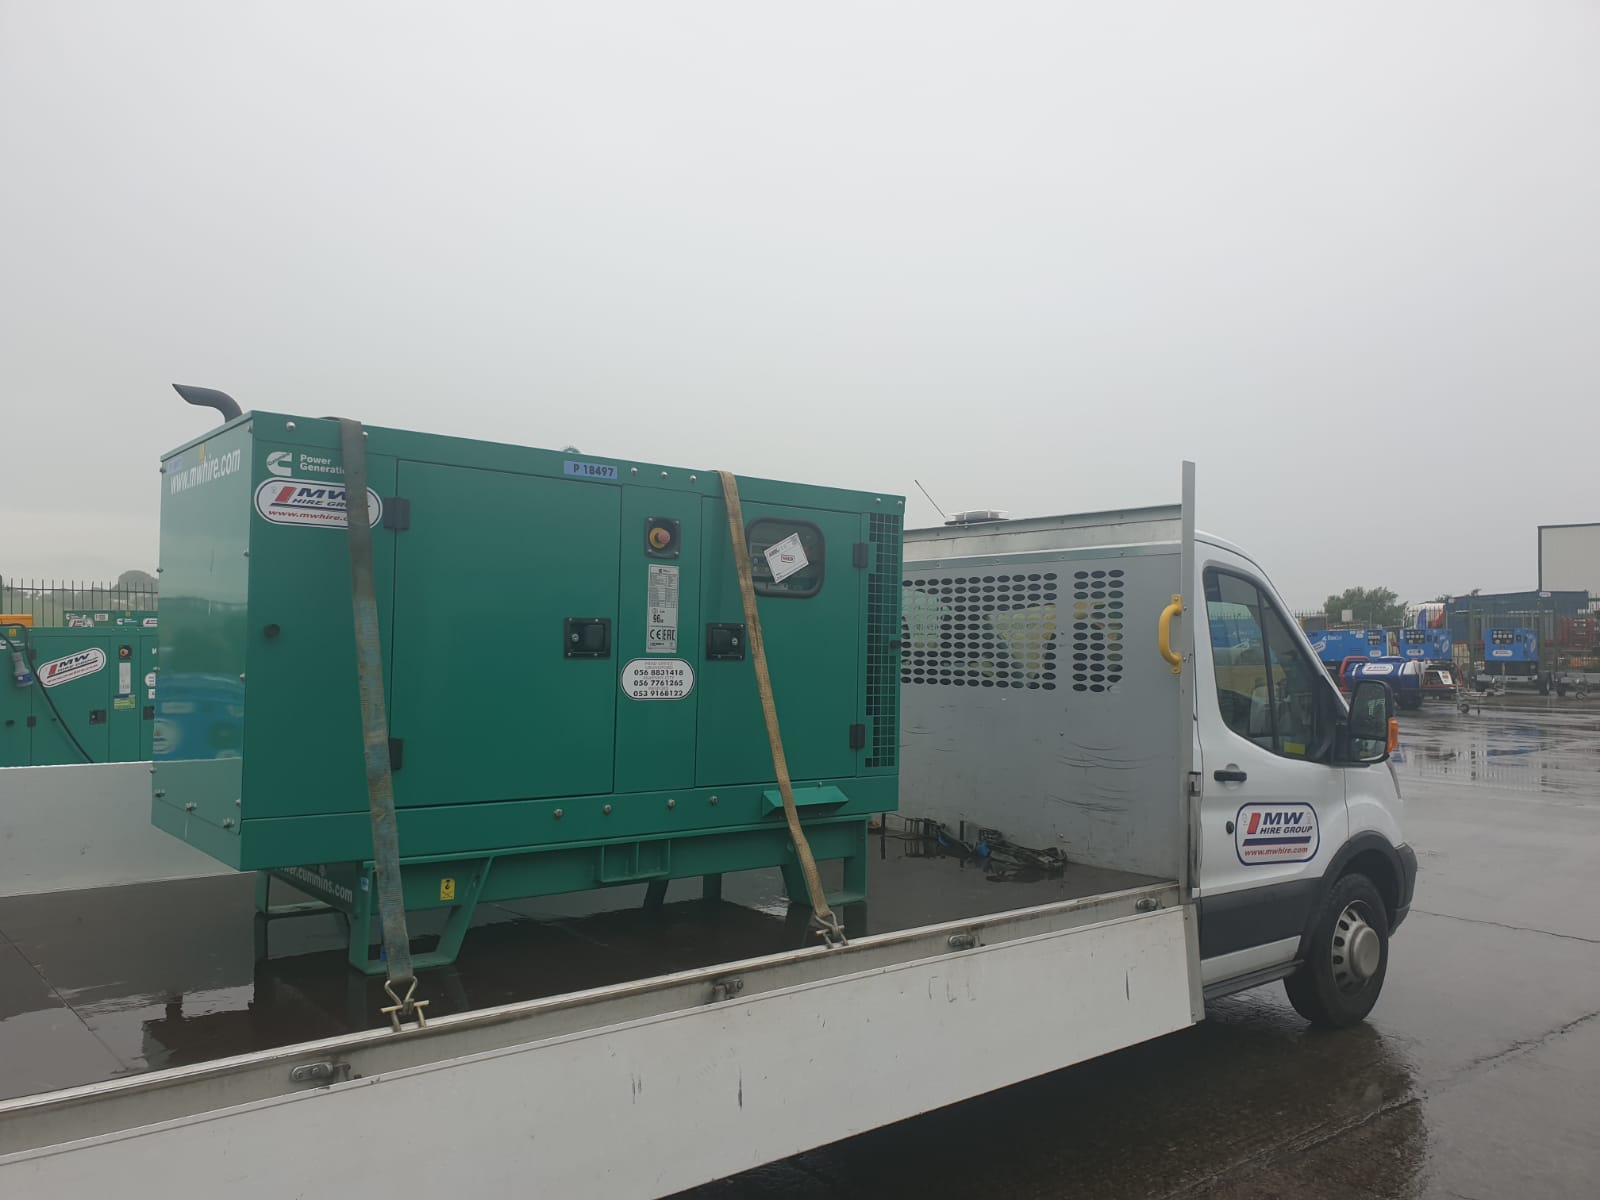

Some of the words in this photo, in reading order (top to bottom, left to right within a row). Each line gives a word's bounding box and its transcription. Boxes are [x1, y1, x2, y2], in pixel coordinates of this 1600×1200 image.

[300, 454, 332, 465] Power
[170, 448, 241, 496] www.mwhire.com
[300, 462, 345, 475] Generati
[573, 463, 580, 473] P
[583, 465, 614, 476] 18497
[292, 498, 323, 507] HIRE
[268, 510, 349, 522] www.mwhire.c
[1263, 812, 1304, 825] MW
[1244, 848, 1308, 856] www.mwhire.com
